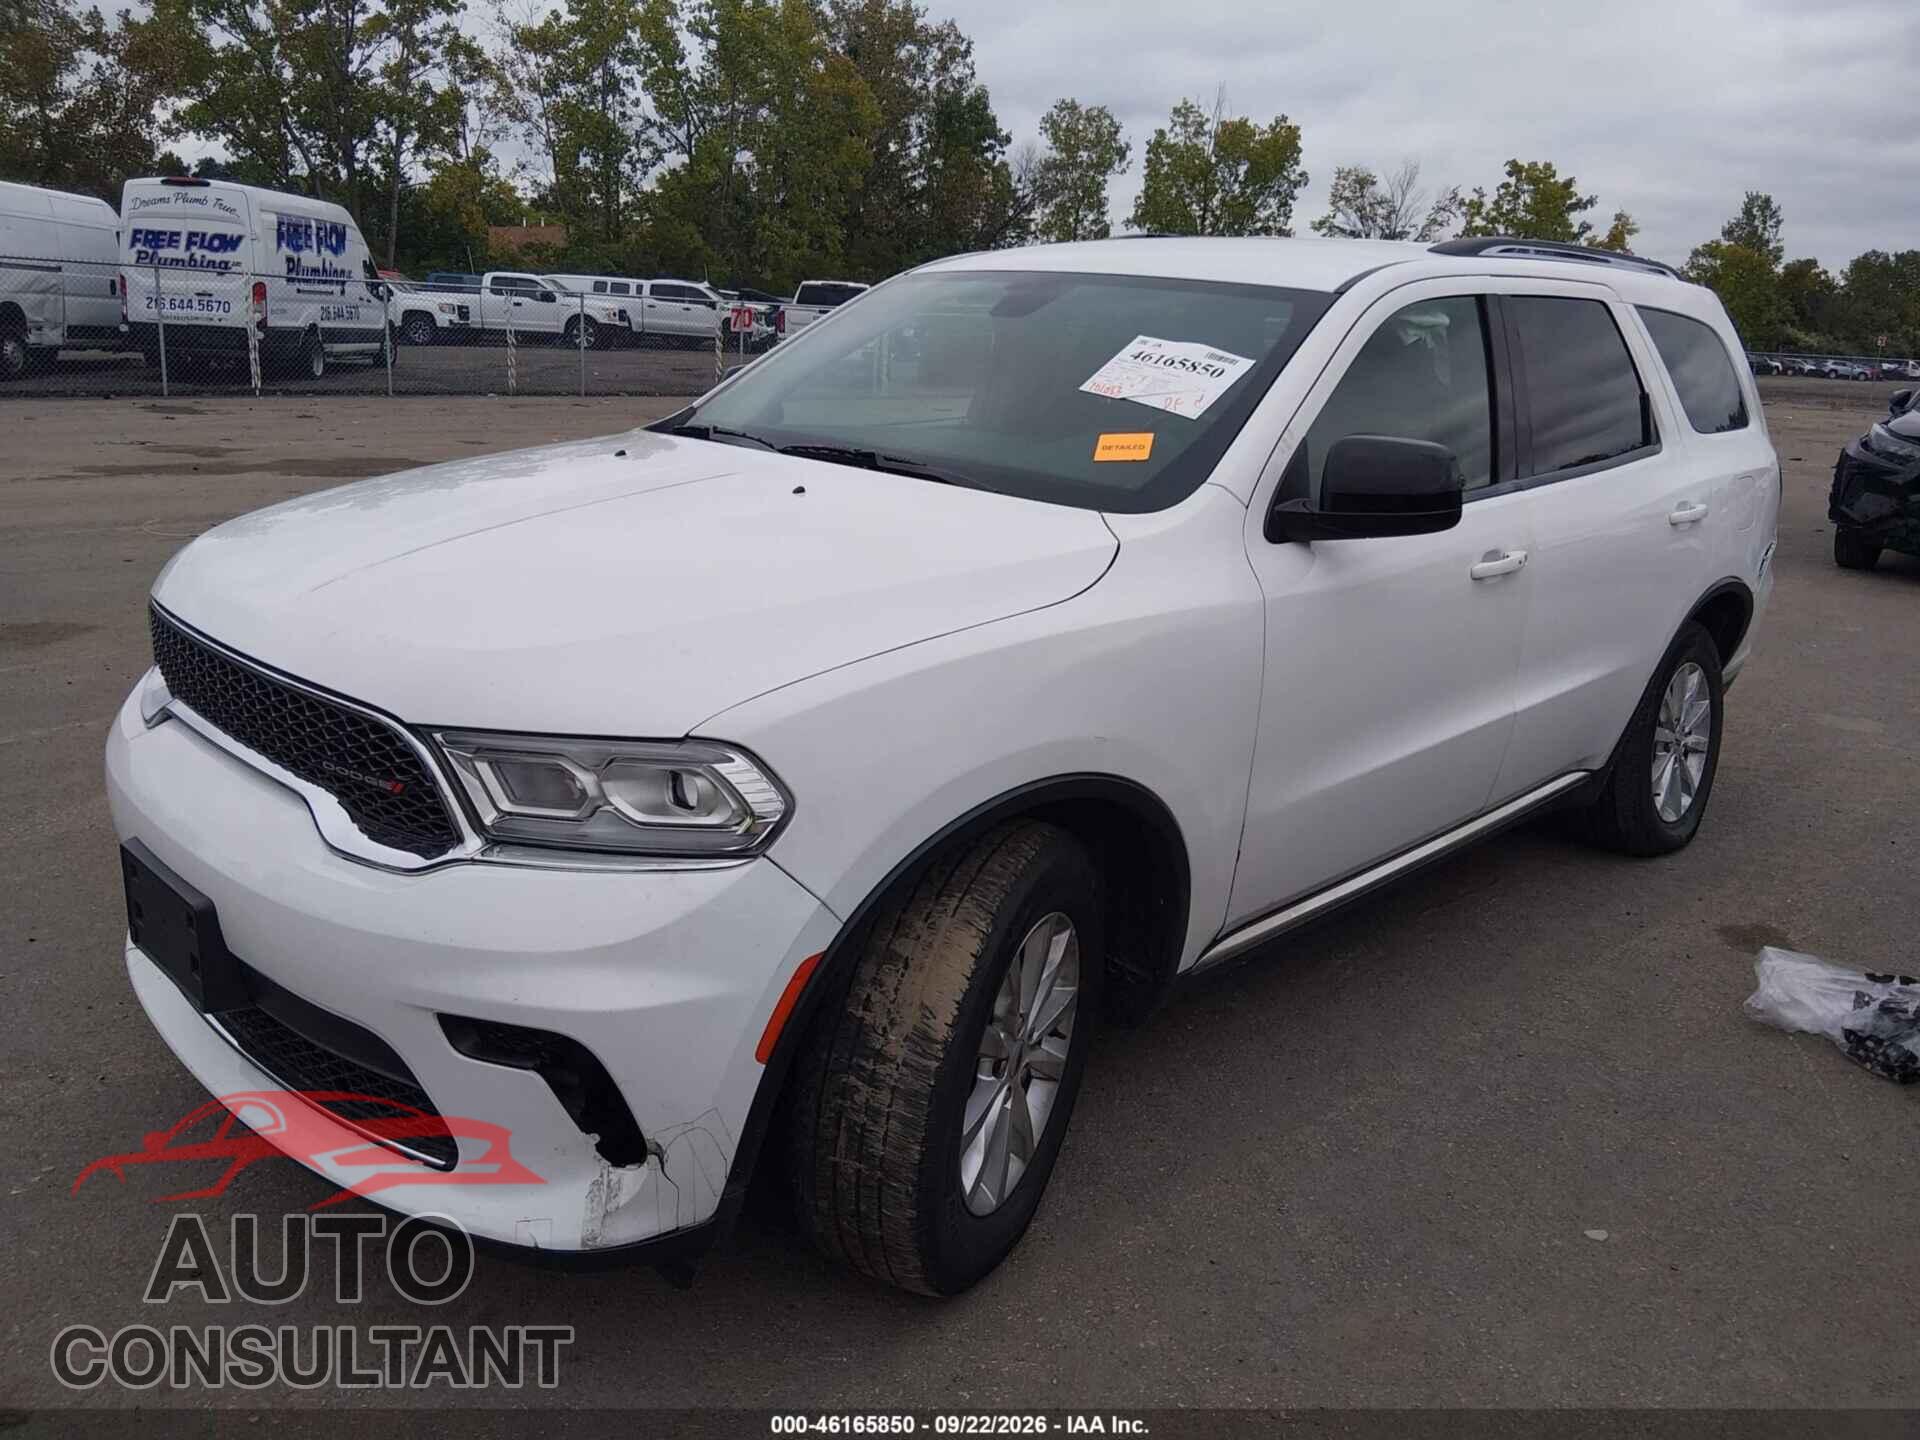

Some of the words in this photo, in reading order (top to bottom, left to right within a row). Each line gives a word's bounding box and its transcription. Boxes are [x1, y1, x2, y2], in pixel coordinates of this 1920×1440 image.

[128, 196, 171, 211] Dreams
[173, 191, 209, 206] Plumb
[129, 229, 182, 249] FREE
[185, 230, 245, 253] FLOW
[276, 215, 314, 254] FREE
[315, 219, 347, 257] FLOW
[135, 249, 232, 275] Plumbing
[285, 255, 347, 296] Plumbing
[146, 296, 232, 314] 216.644.5670
[731, 307, 753, 329] 70
[1130, 351, 1225, 378] 46165850
